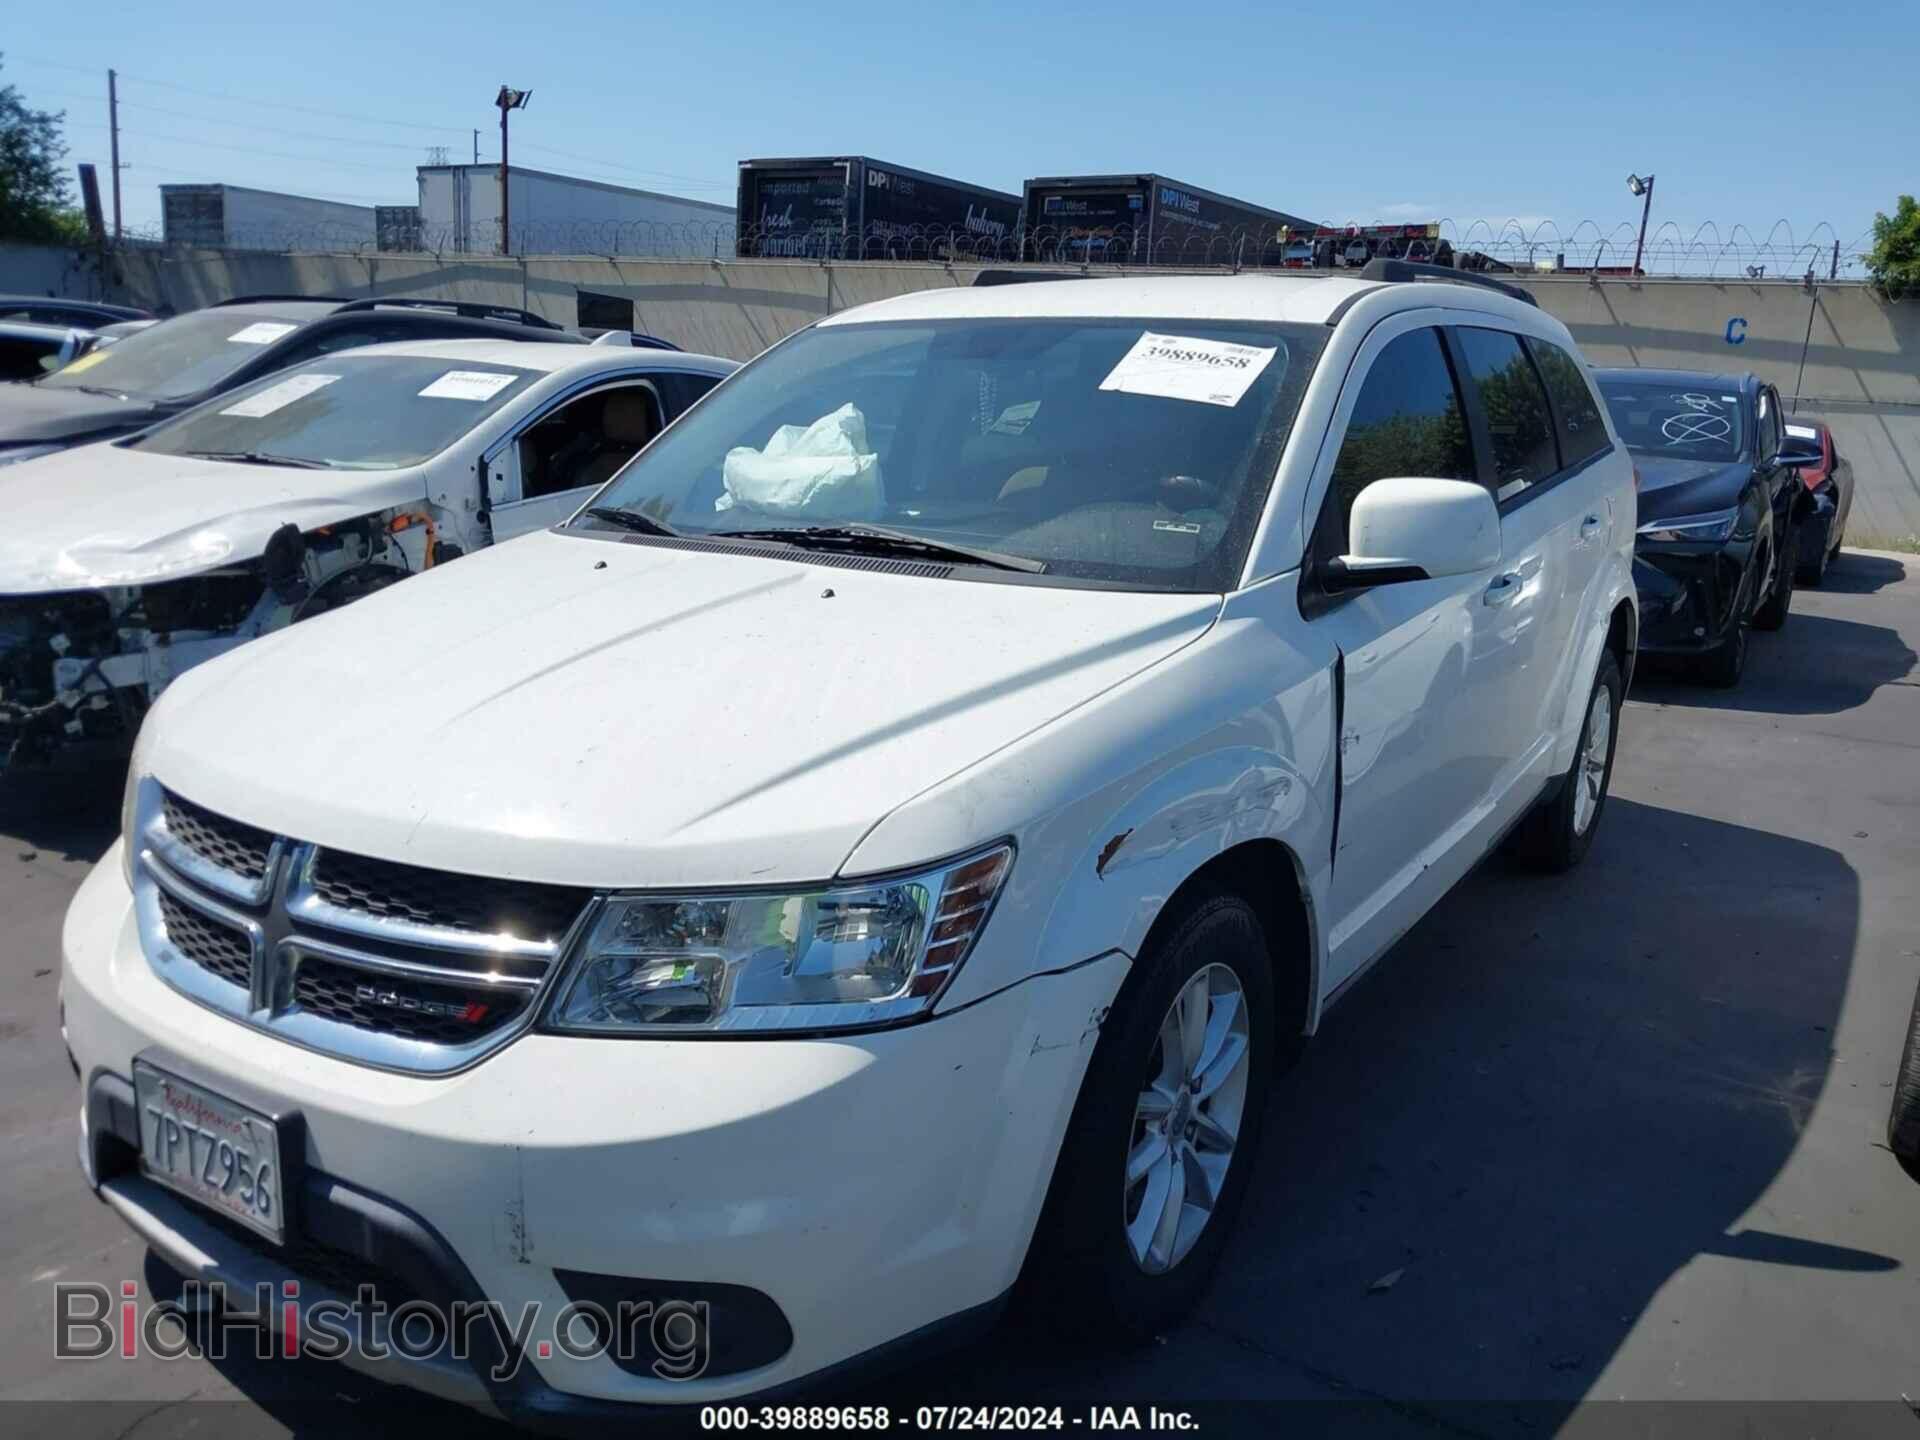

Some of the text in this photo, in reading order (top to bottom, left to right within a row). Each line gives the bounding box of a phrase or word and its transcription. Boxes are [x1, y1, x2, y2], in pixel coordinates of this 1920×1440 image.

[1160, 188, 1178, 206] DPI
[1725, 317, 1747, 344] C
[1142, 346, 1252, 370] 39889658
[356, 985, 467, 1017] DODGE
[146, 1105, 270, 1218] 7PTZ956
